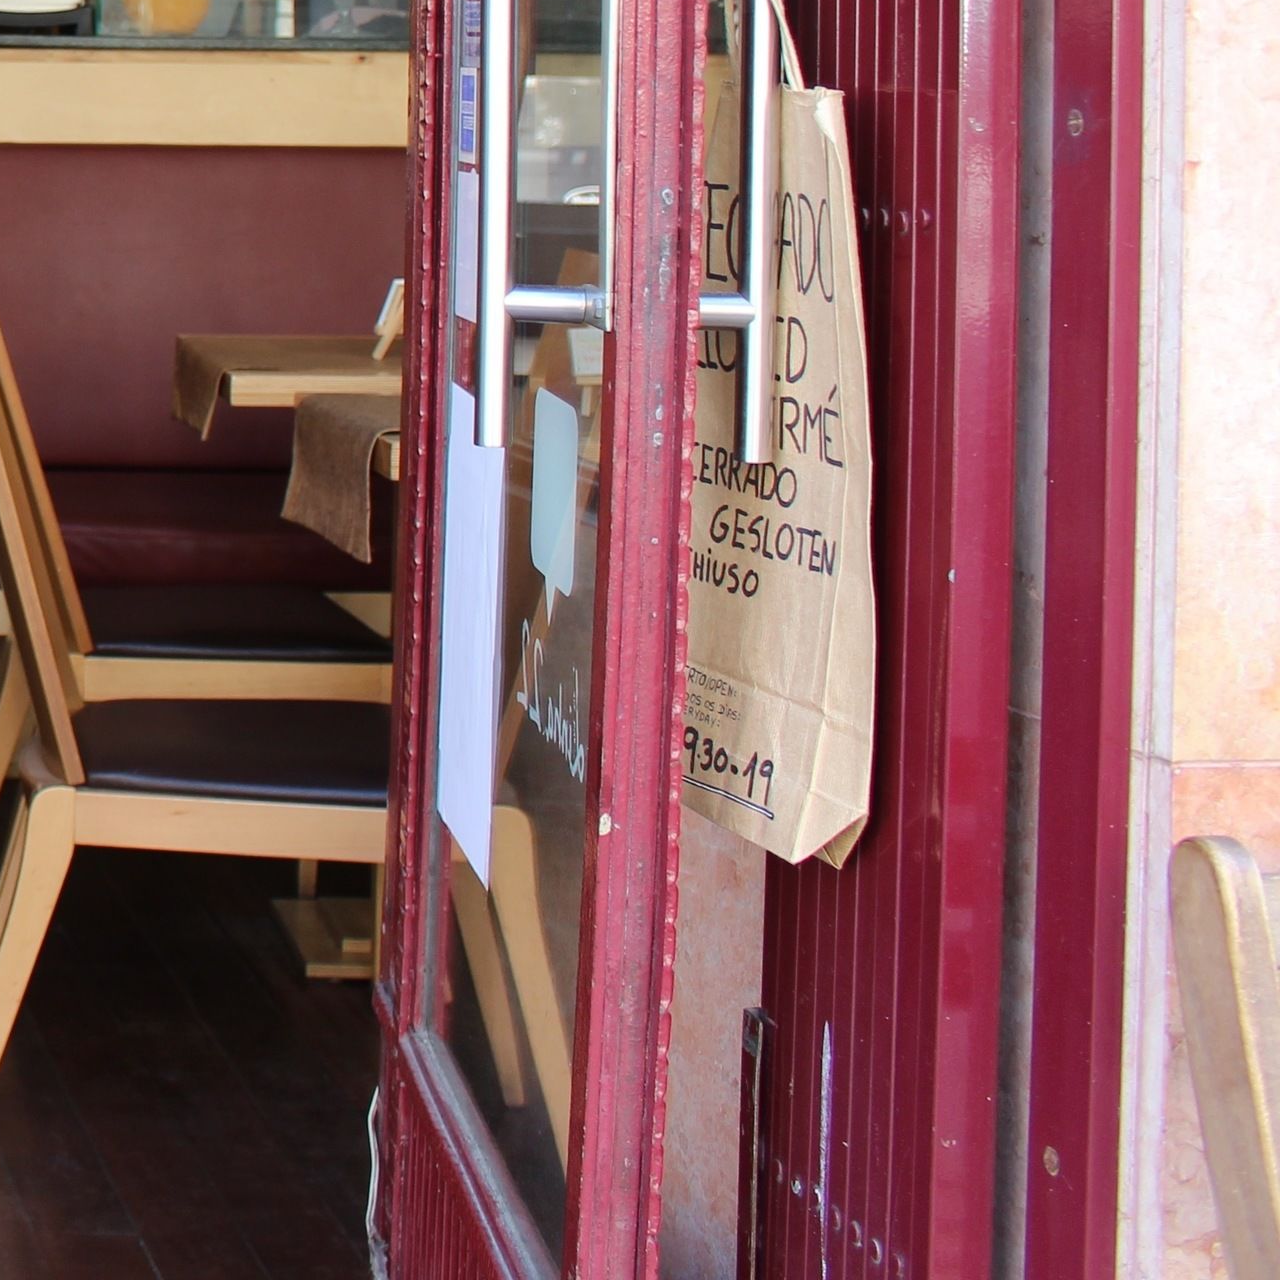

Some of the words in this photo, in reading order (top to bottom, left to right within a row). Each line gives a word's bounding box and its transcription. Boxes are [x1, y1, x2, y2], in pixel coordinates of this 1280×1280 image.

[773, 384, 844, 468] RMÉ
[692, 441, 797, 508] ERRADO
[709, 504, 836, 577] GESLOTEN
[686, 664, 737, 698] RTO/OPEN:
